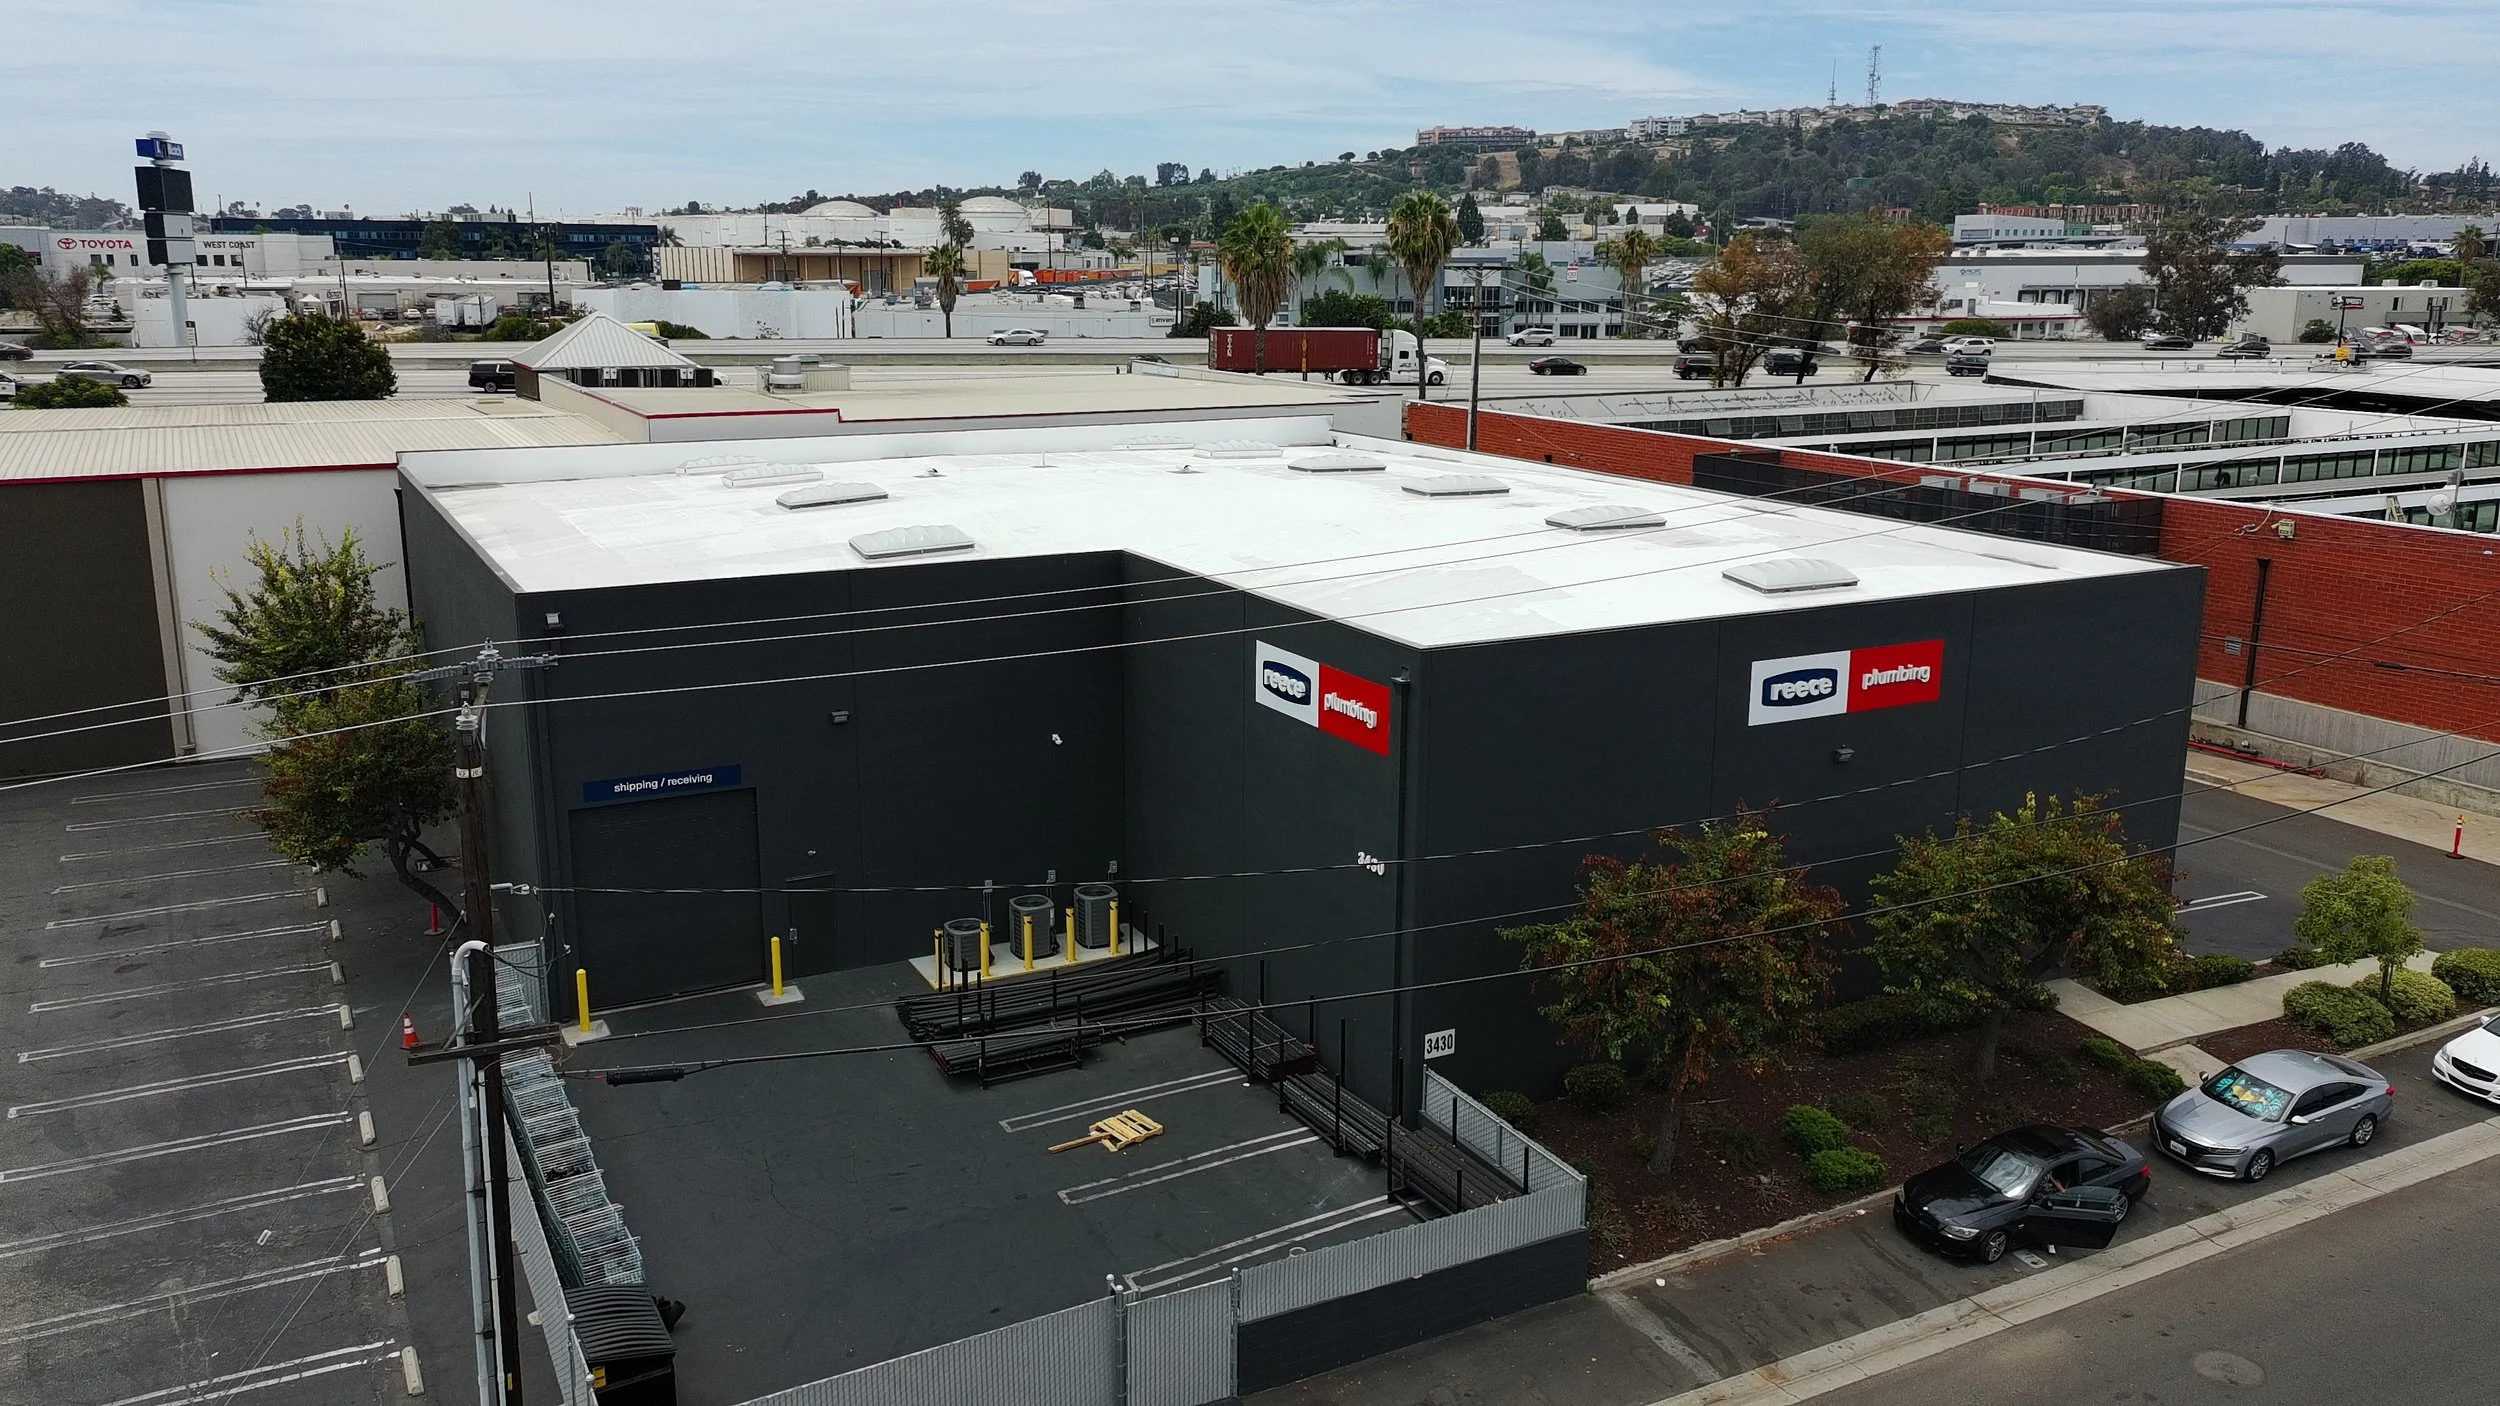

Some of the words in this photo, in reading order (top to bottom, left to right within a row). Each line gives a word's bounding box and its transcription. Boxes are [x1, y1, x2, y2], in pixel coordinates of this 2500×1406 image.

[79, 239, 133, 249] TOYOTA
[203, 241, 226, 249] WEST
[228, 241, 255, 249] COAST
[1769, 676, 1833, 701] reece
[1861, 664, 1931, 690] plumbing
[1263, 668, 1306, 699] reece
[1323, 692, 1378, 729] plumbing
[614, 779, 658, 793] shipping
[667, 773, 713, 786] receiving
[1426, 1033, 1454, 1054] 3430
